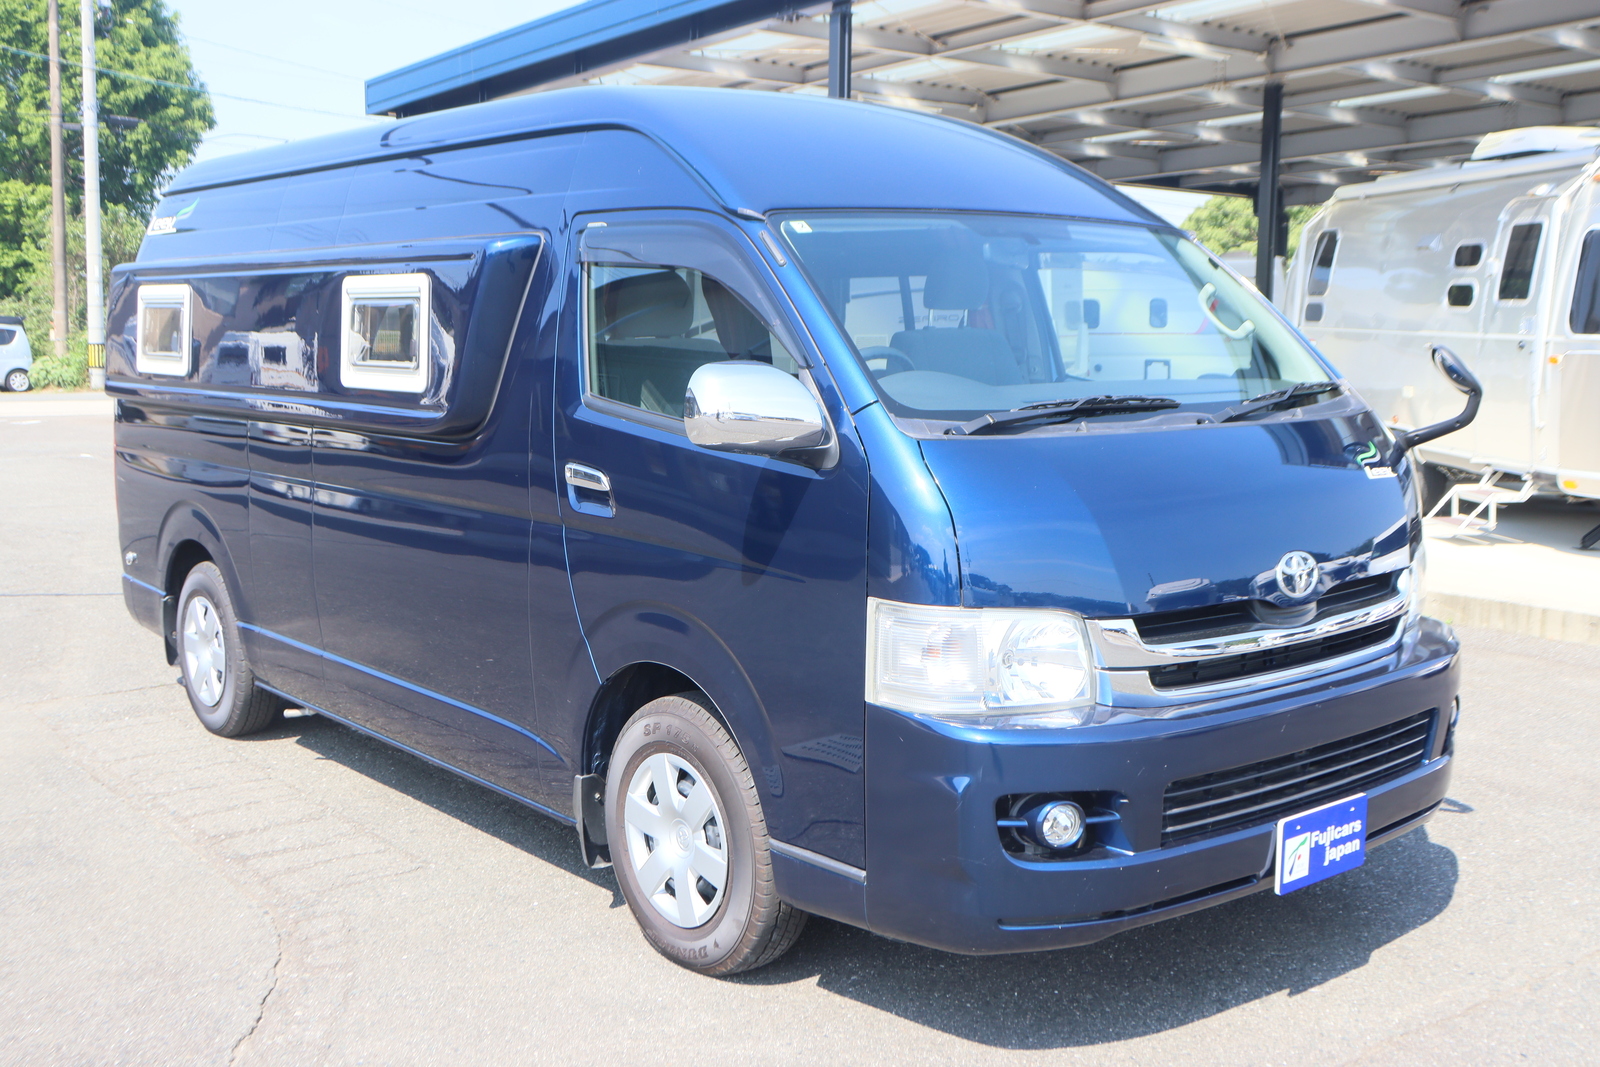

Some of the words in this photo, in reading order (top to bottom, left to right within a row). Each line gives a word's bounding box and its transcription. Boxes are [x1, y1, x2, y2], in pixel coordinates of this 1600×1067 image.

[643, 722, 662, 737] SP
[1310, 820, 1362, 848] Fujicars
[1323, 839, 1360, 866] japan
